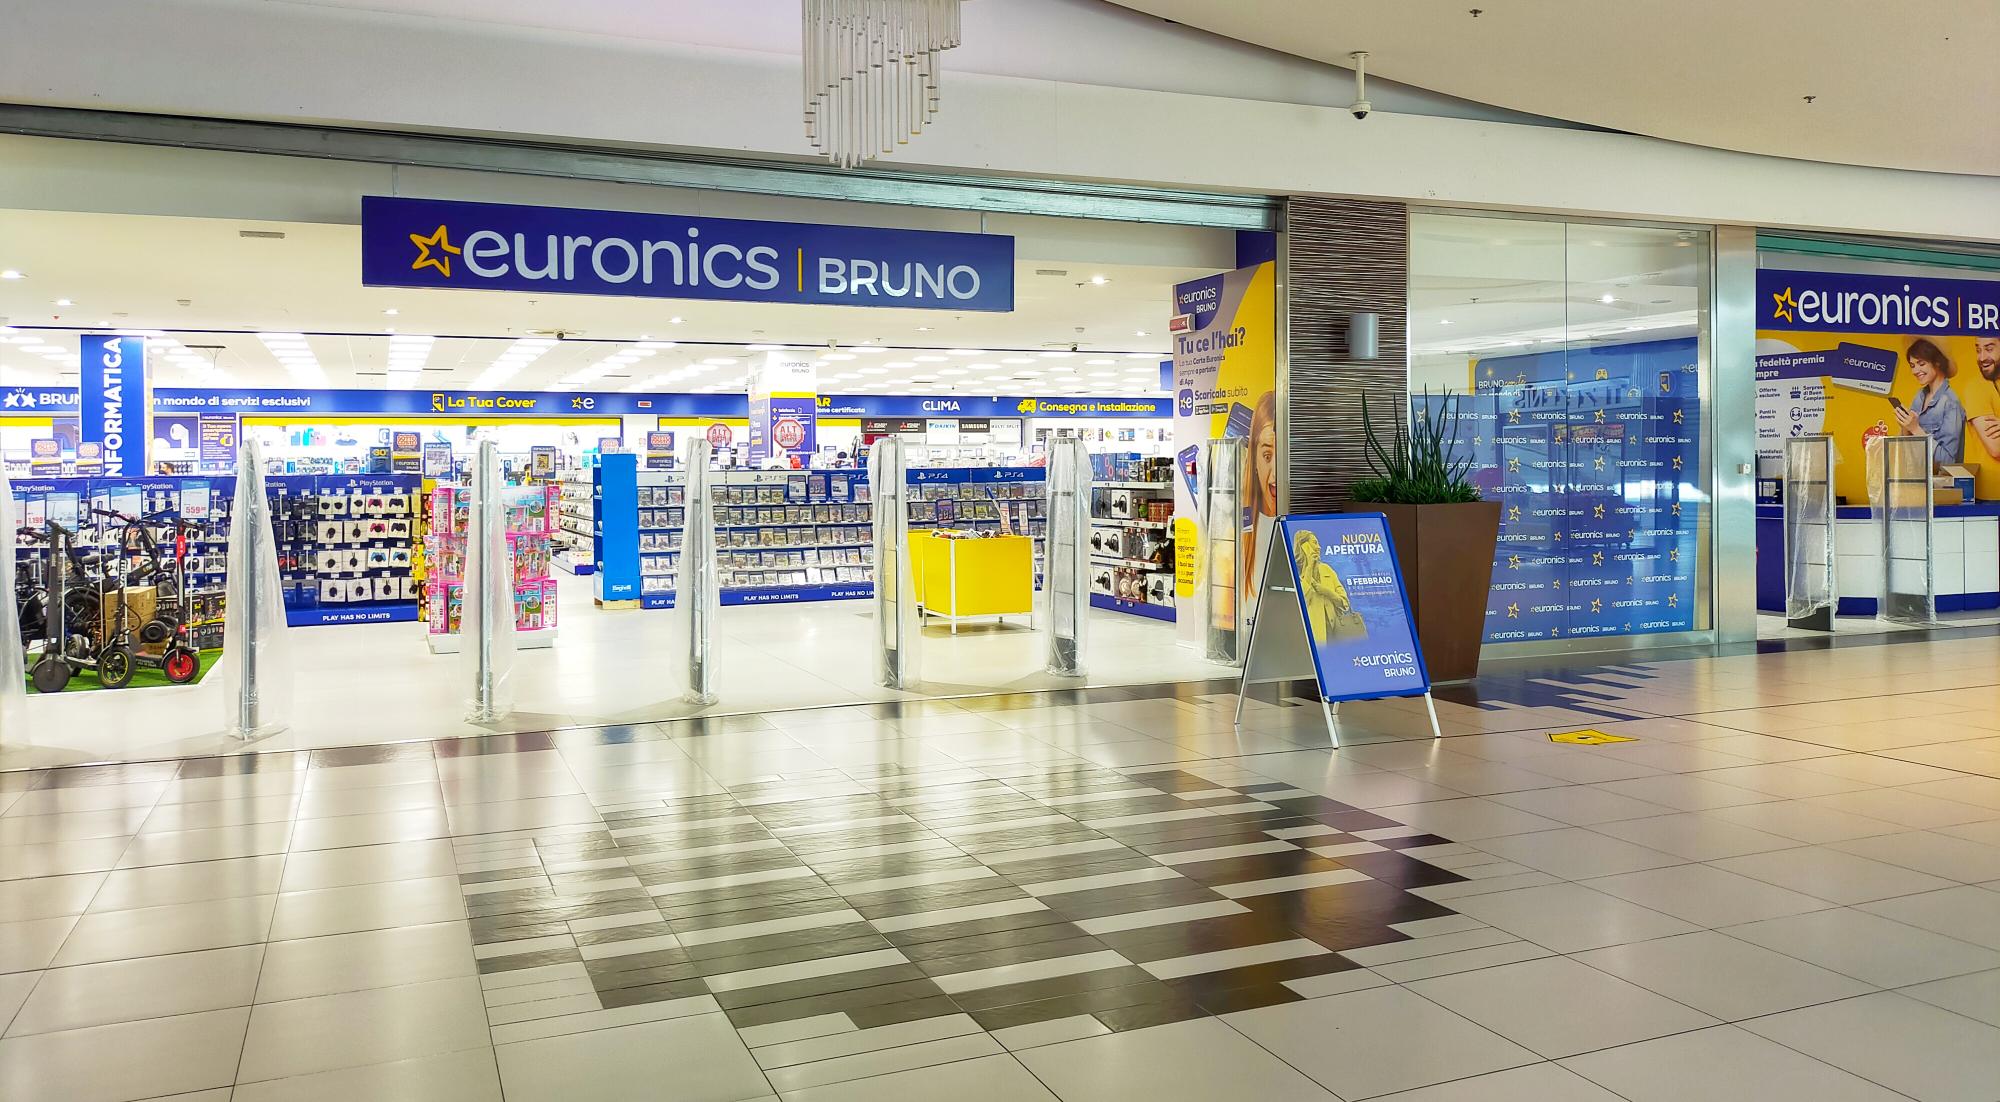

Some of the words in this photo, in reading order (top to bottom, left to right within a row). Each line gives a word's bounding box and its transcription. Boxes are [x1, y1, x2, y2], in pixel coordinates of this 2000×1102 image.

[464, 227, 779, 290] euronics
[818, 257, 980, 300] BRUNO
[1184, 287, 1216, 304] euronics
[1196, 302, 1216, 313] BRUNO
[1798, 285, 1950, 328] euronics
[1179, 336, 1193, 355] Tu
[1196, 340, 1209, 352] ce
[1212, 327, 1246, 350] l'hai?
[1760, 357, 1791, 367] fedeltà
[1792, 355, 1824, 366] premia
[1849, 358, 1886, 372] euronics
[1756, 371, 1779, 379] mpre
[1479, 380, 1504, 389] BRUNO
[1195, 388, 1226, 400] Scaricala
[1227, 386, 1248, 397] subito
[40, 393, 79, 404] BRUN
[163, 396, 205, 406] mondo
[208, 396, 219, 406] di
[222, 397, 259, 406] servizi
[262, 397, 310, 406] esclusivi
[448, 397, 464, 407] La
[468, 397, 494, 408] Tua
[496, 397, 536, 408] Cover
[817, 398, 831, 406] AR
[1187, 396, 1192, 408] e
[103, 337, 122, 477] NFORMATICA
[922, 401, 960, 411] CLIMA
[1040, 402, 1087, 414] Consegna
[1097, 402, 1156, 412] Installazione
[1537, 460, 1566, 468] euronics
[359, 480, 393, 490] PlayStation
[1496, 484, 1527, 492] euronics
[1342, 533, 1381, 544] NUOVA
[1325, 544, 1385, 556] APERTURA
[1536, 556, 1565, 564] euronics
[1618, 552, 1644, 560] euronics
[1574, 578, 1601, 586] euronics
[1646, 574, 1671, 582] euronics
[1496, 582, 1526, 590] euronics
[1615, 598, 1642, 607] euronics
[1535, 604, 1563, 612] euronics
[1572, 625, 1599, 633] euronics
[1644, 620, 1669, 628] euronics
[1495, 630, 1524, 639] euronics
[1361, 651, 1412, 667] euronics
[1384, 667, 1415, 678] BRUNO
